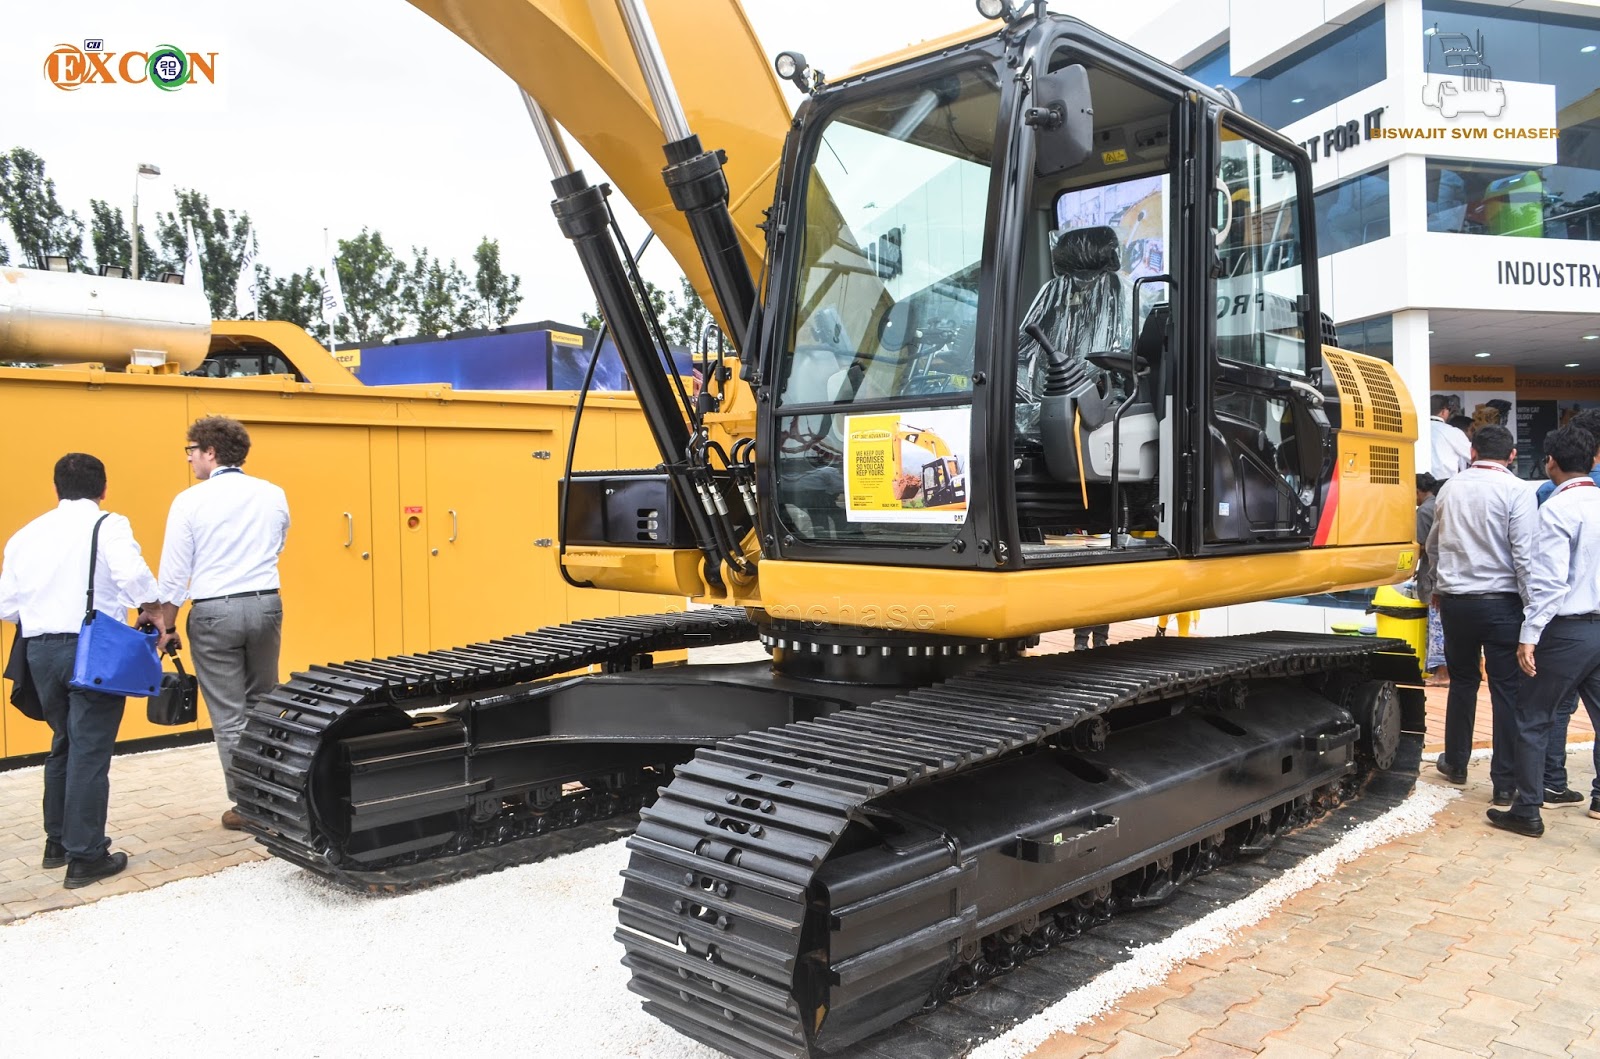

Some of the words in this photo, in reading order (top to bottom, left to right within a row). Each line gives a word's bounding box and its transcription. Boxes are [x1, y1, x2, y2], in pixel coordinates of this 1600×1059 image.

[1323, 119, 1360, 157] FOR
[1364, 107, 1384, 140] IT
[1498, 261, 1600, 288] INDUSTRY
[1443, 374, 1471, 383] Defence
[1472, 374, 1504, 383] Solutions
